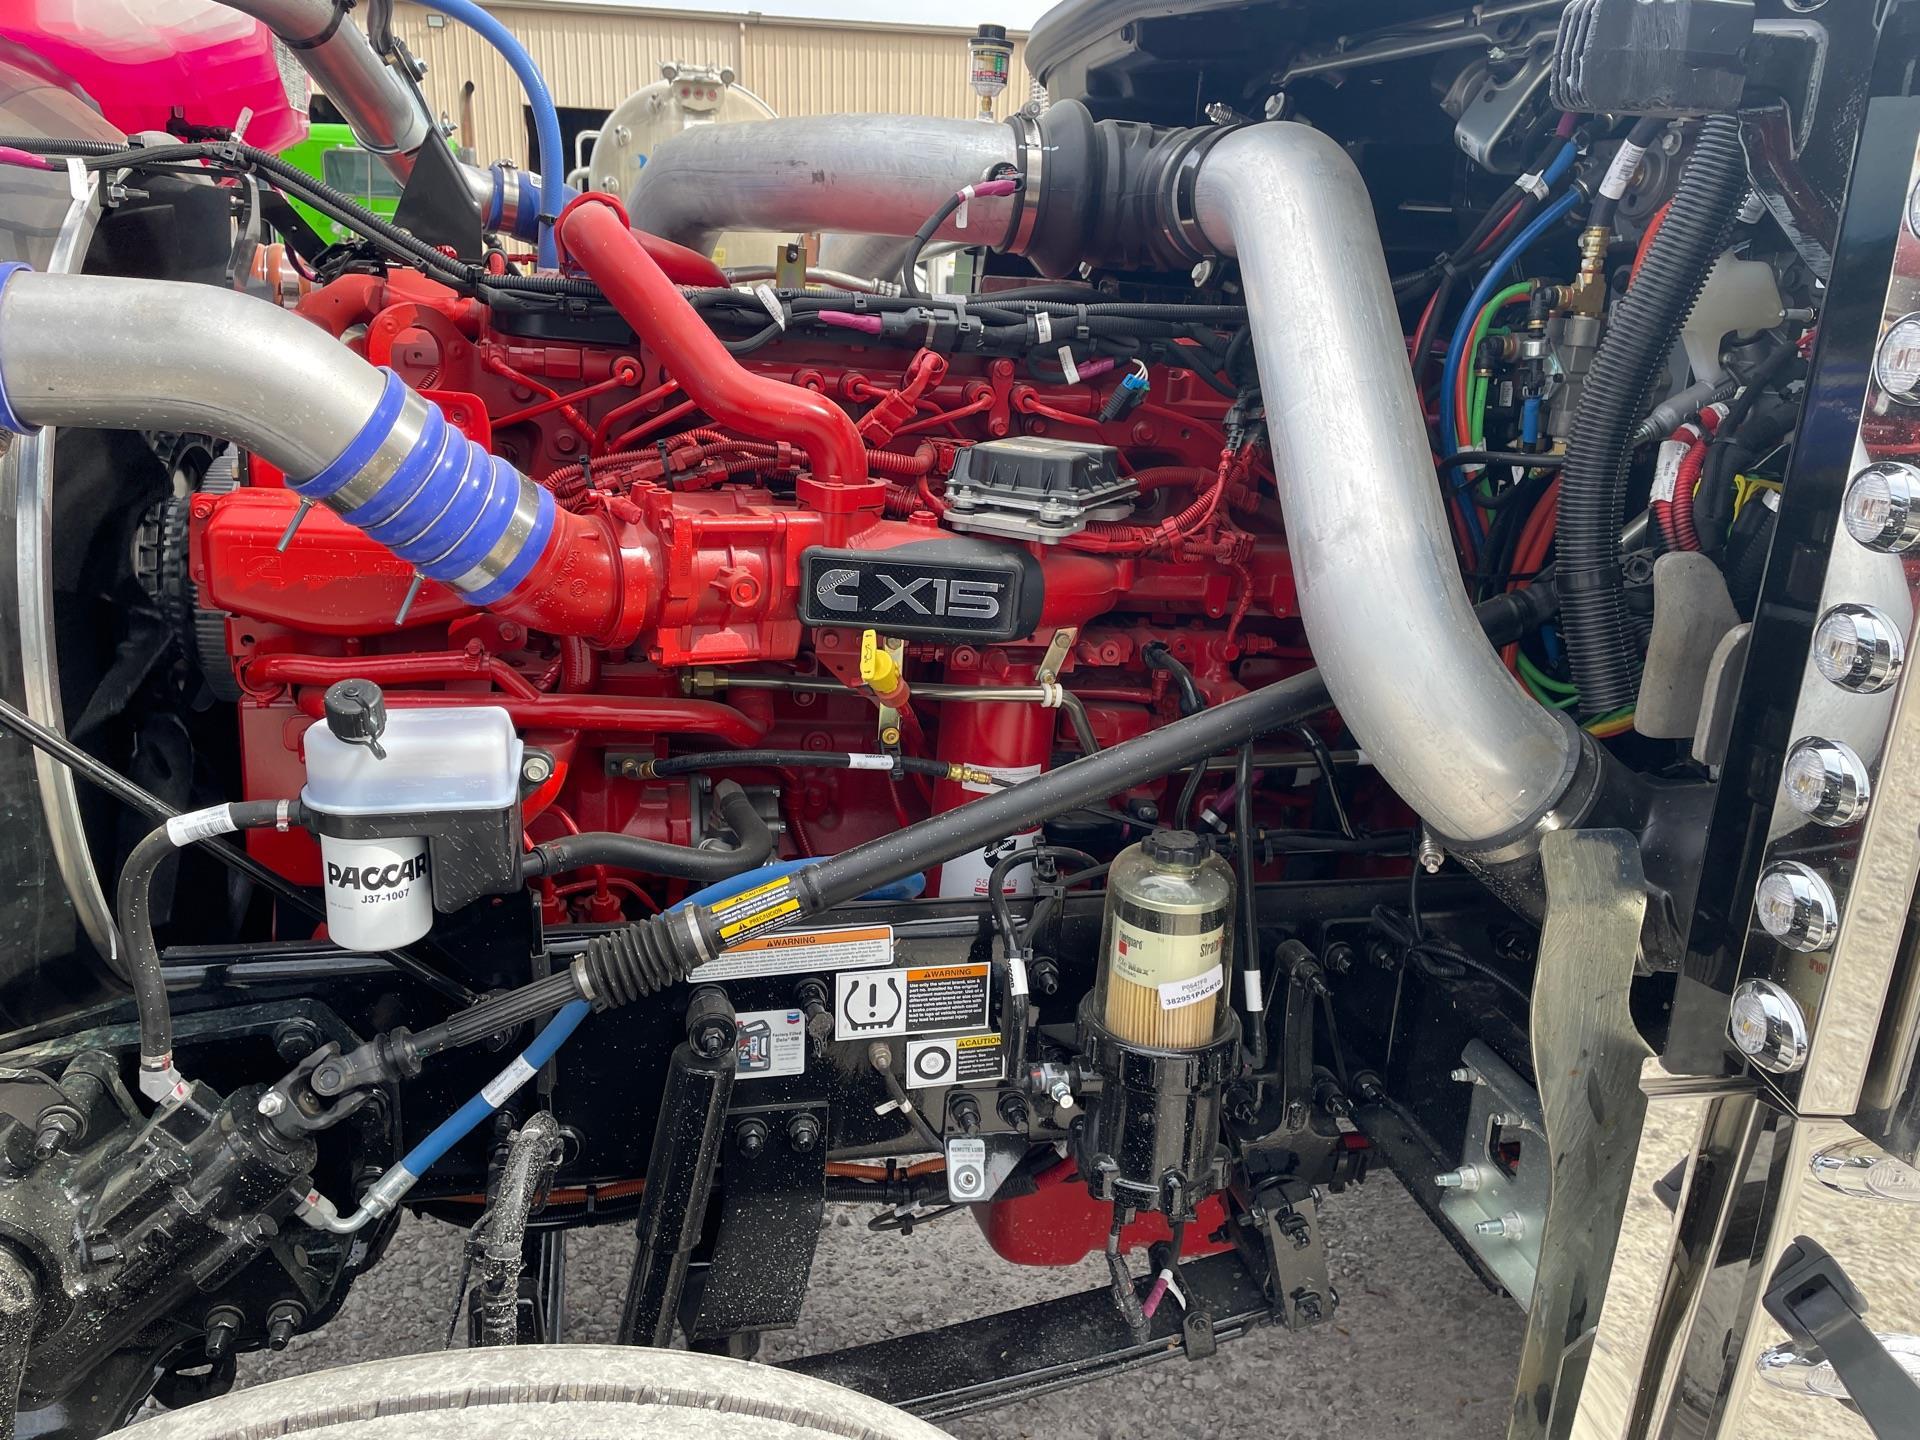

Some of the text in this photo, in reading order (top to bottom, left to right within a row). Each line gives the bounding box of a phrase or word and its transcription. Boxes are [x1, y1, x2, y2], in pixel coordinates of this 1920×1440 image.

[818, 571, 855, 595] Cummins
[872, 574, 1000, 619] X15
[984, 840, 1015, 858] Cummins
[327, 852, 427, 891] PACCAR
[361, 887, 409, 904] J37-1007
[773, 936, 816, 947] WARNING
[931, 968, 972, 978] WARNING
[966, 1036, 1002, 1047] CAUTION
